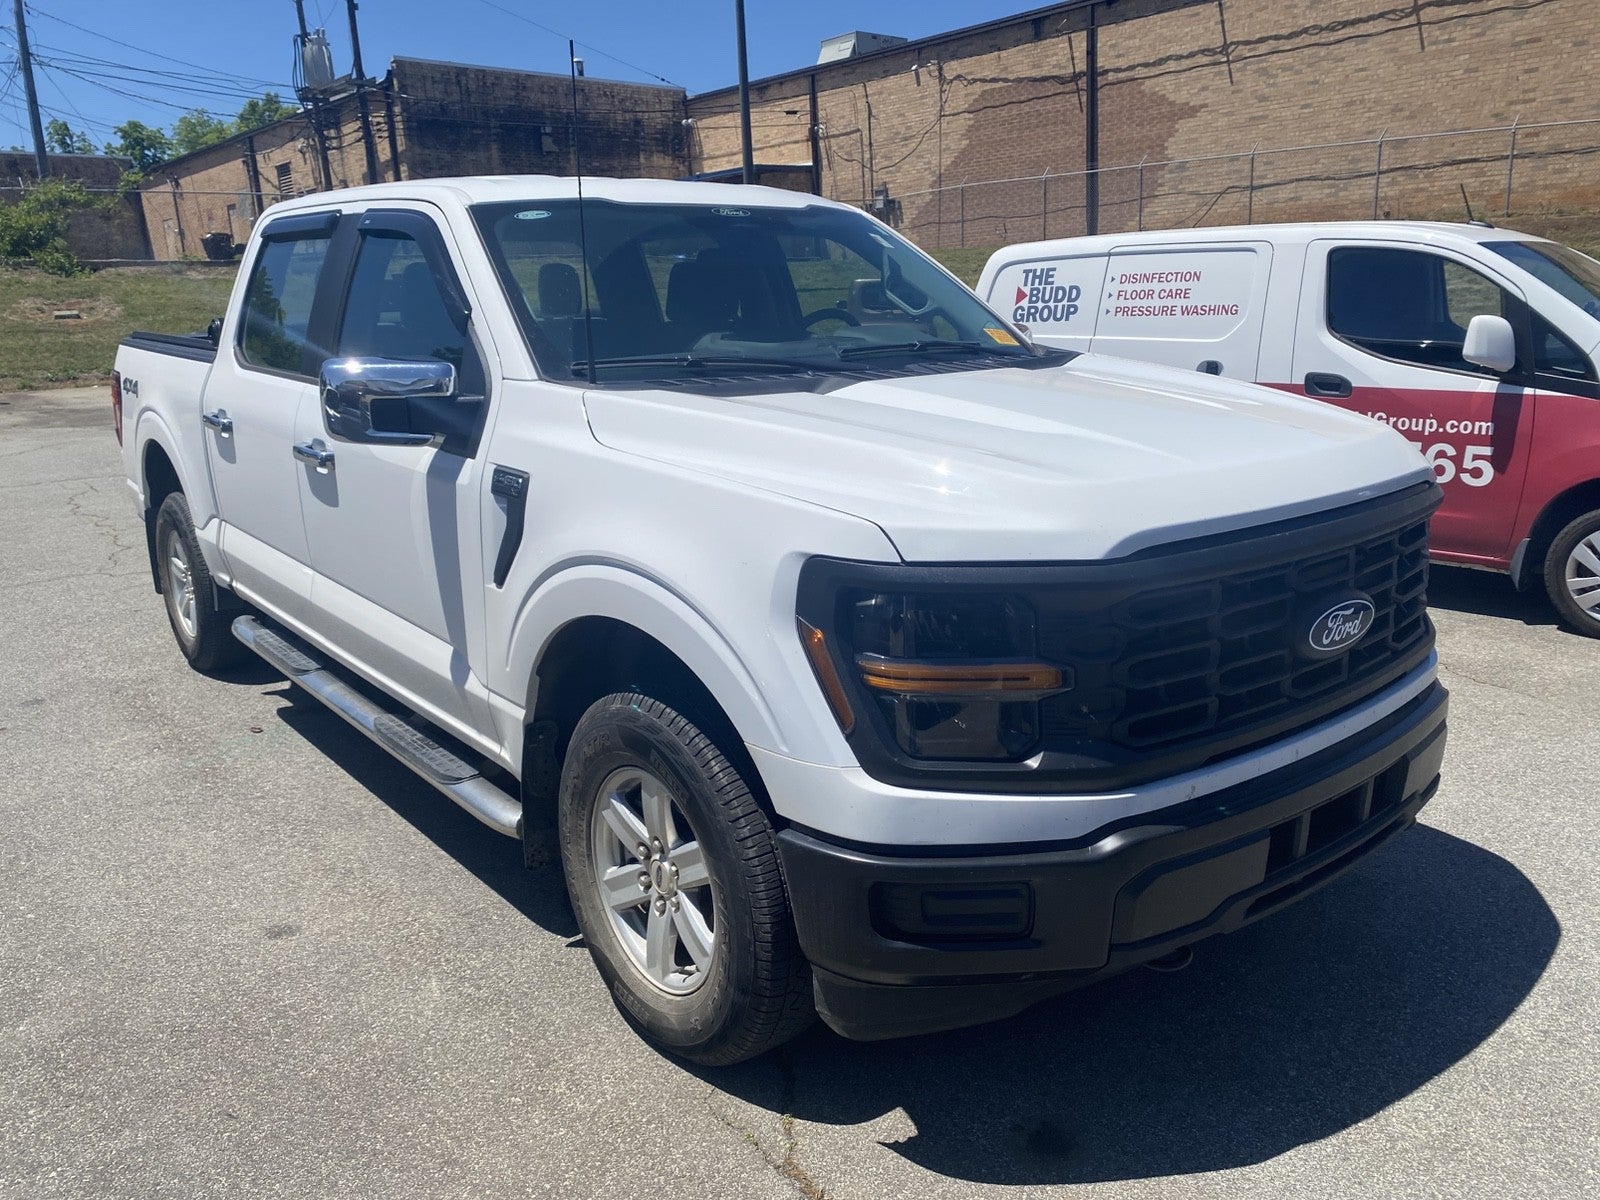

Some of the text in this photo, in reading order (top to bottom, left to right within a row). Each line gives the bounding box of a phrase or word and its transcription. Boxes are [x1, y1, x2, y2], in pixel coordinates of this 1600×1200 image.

[1022, 267, 1057, 287] THE
[1119, 271, 1202, 284] DISINFECTION
[1027, 285, 1081, 304] BUDD
[1116, 288, 1192, 301] FLOOR CARE
[1012, 304, 1079, 323] GROUP
[1114, 304, 1240, 317] PRESSURE WASHING
[1357, 411, 1494, 436] Group.com
[1322, 607, 1364, 645] Ford
